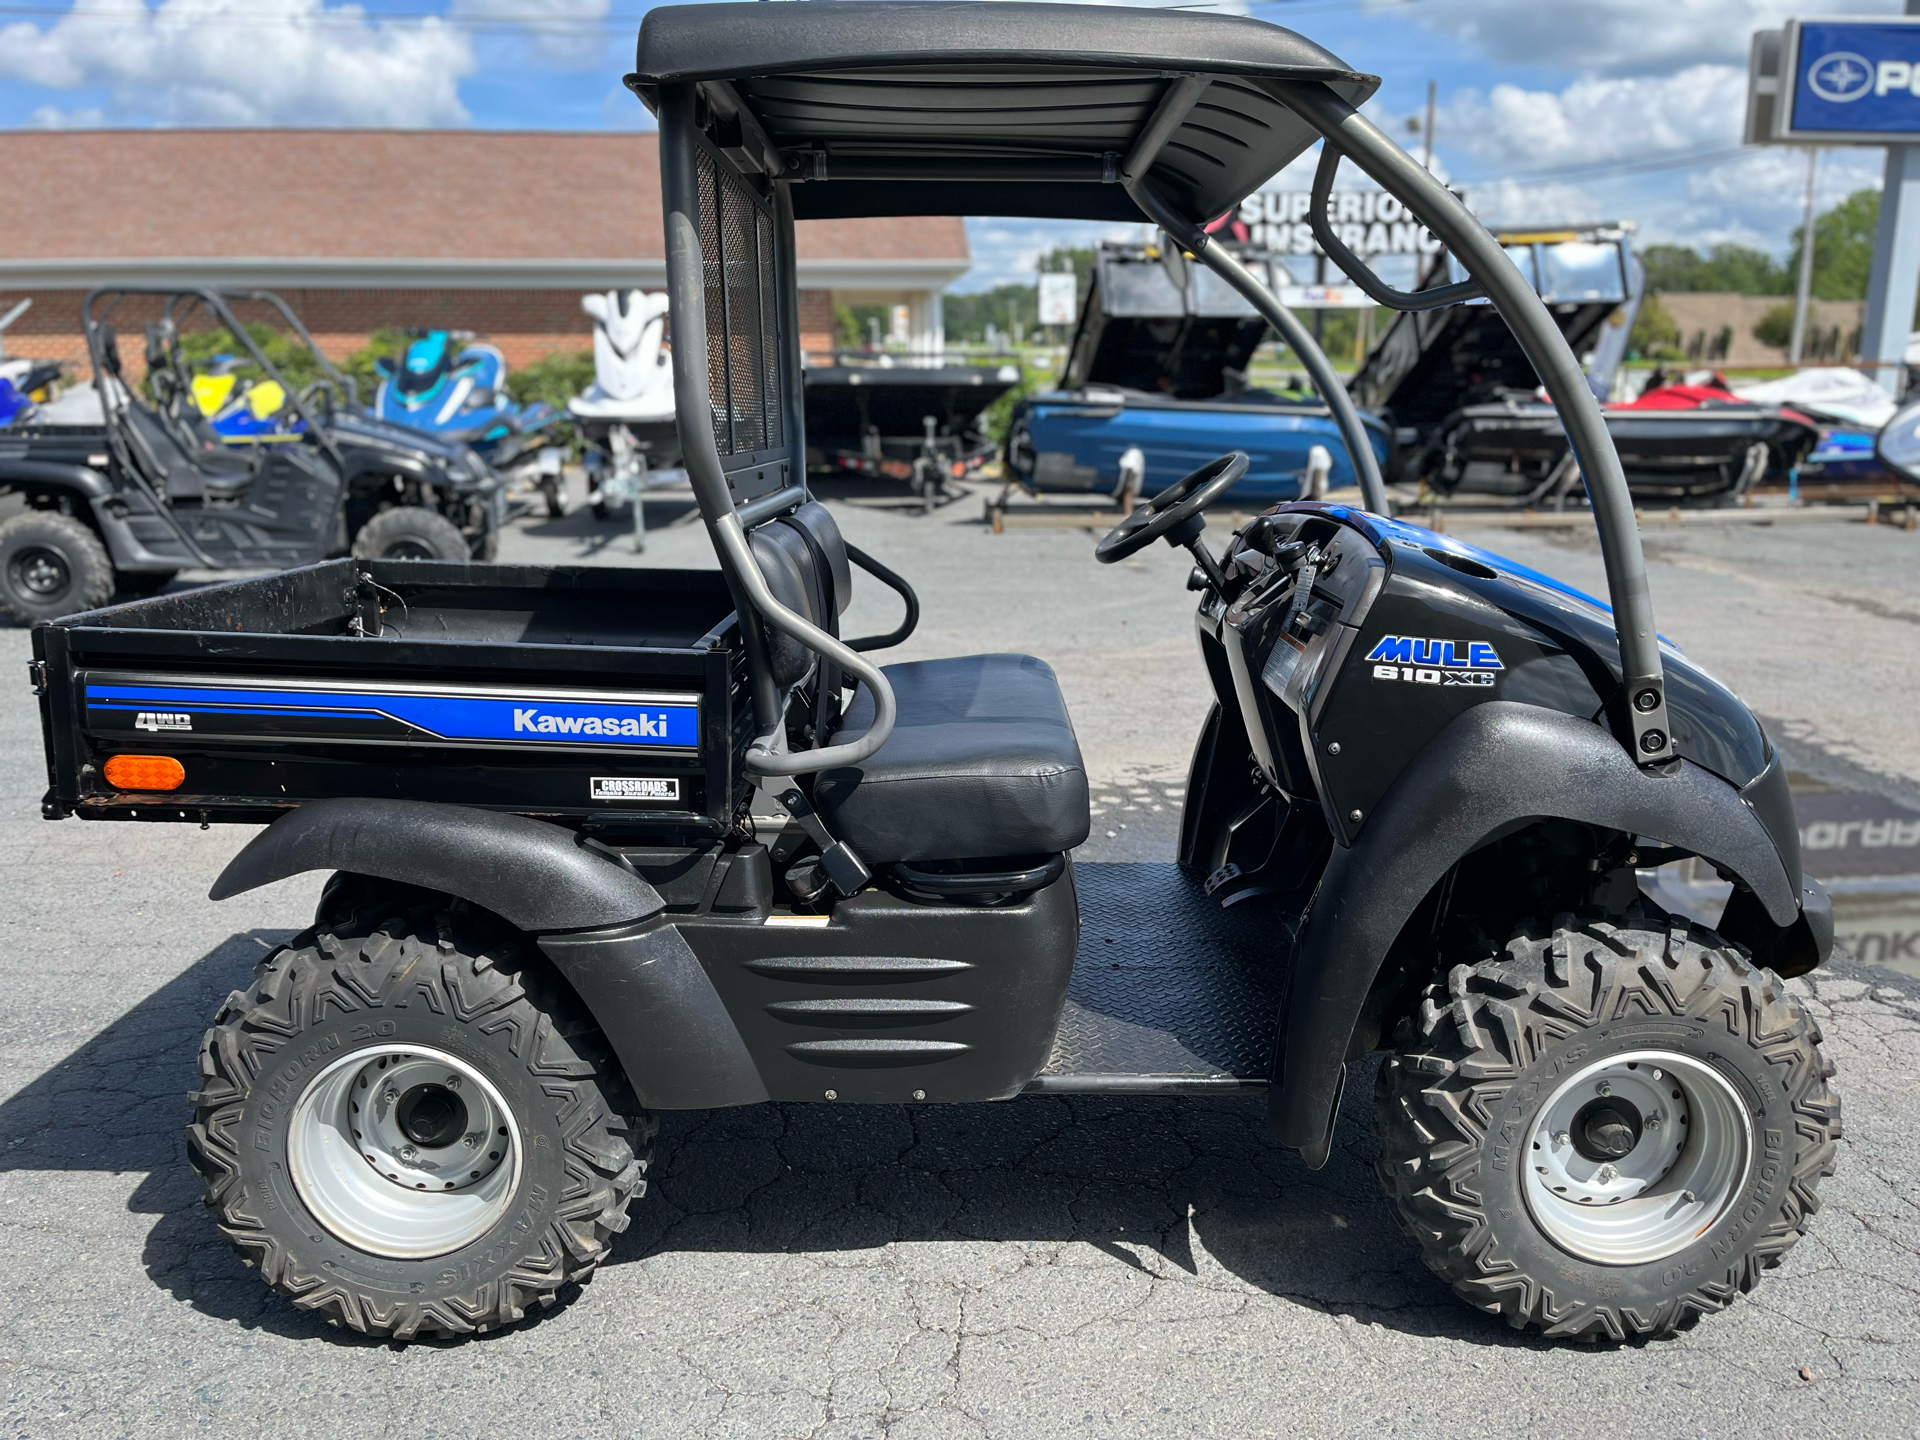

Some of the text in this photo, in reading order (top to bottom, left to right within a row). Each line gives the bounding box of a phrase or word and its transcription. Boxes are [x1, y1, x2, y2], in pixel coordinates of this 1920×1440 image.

[1251, 222, 1442, 254] INSRANC
[1364, 634, 1506, 670] MULE
[135, 712, 192, 731] 4WD
[513, 708, 667, 737] Kawasaki
[601, 780, 668, 792] CROSSROADS
[254, 1033, 340, 1152] BIGHORN
[350, 1020, 396, 1042] 2.0
[1492, 1043, 1588, 1171] MAXXIS
[257, 1178, 277, 1211] RADIAL
[1711, 1128, 1783, 1260] BIGHORN
[436, 1183, 548, 1287] MAXXIS
